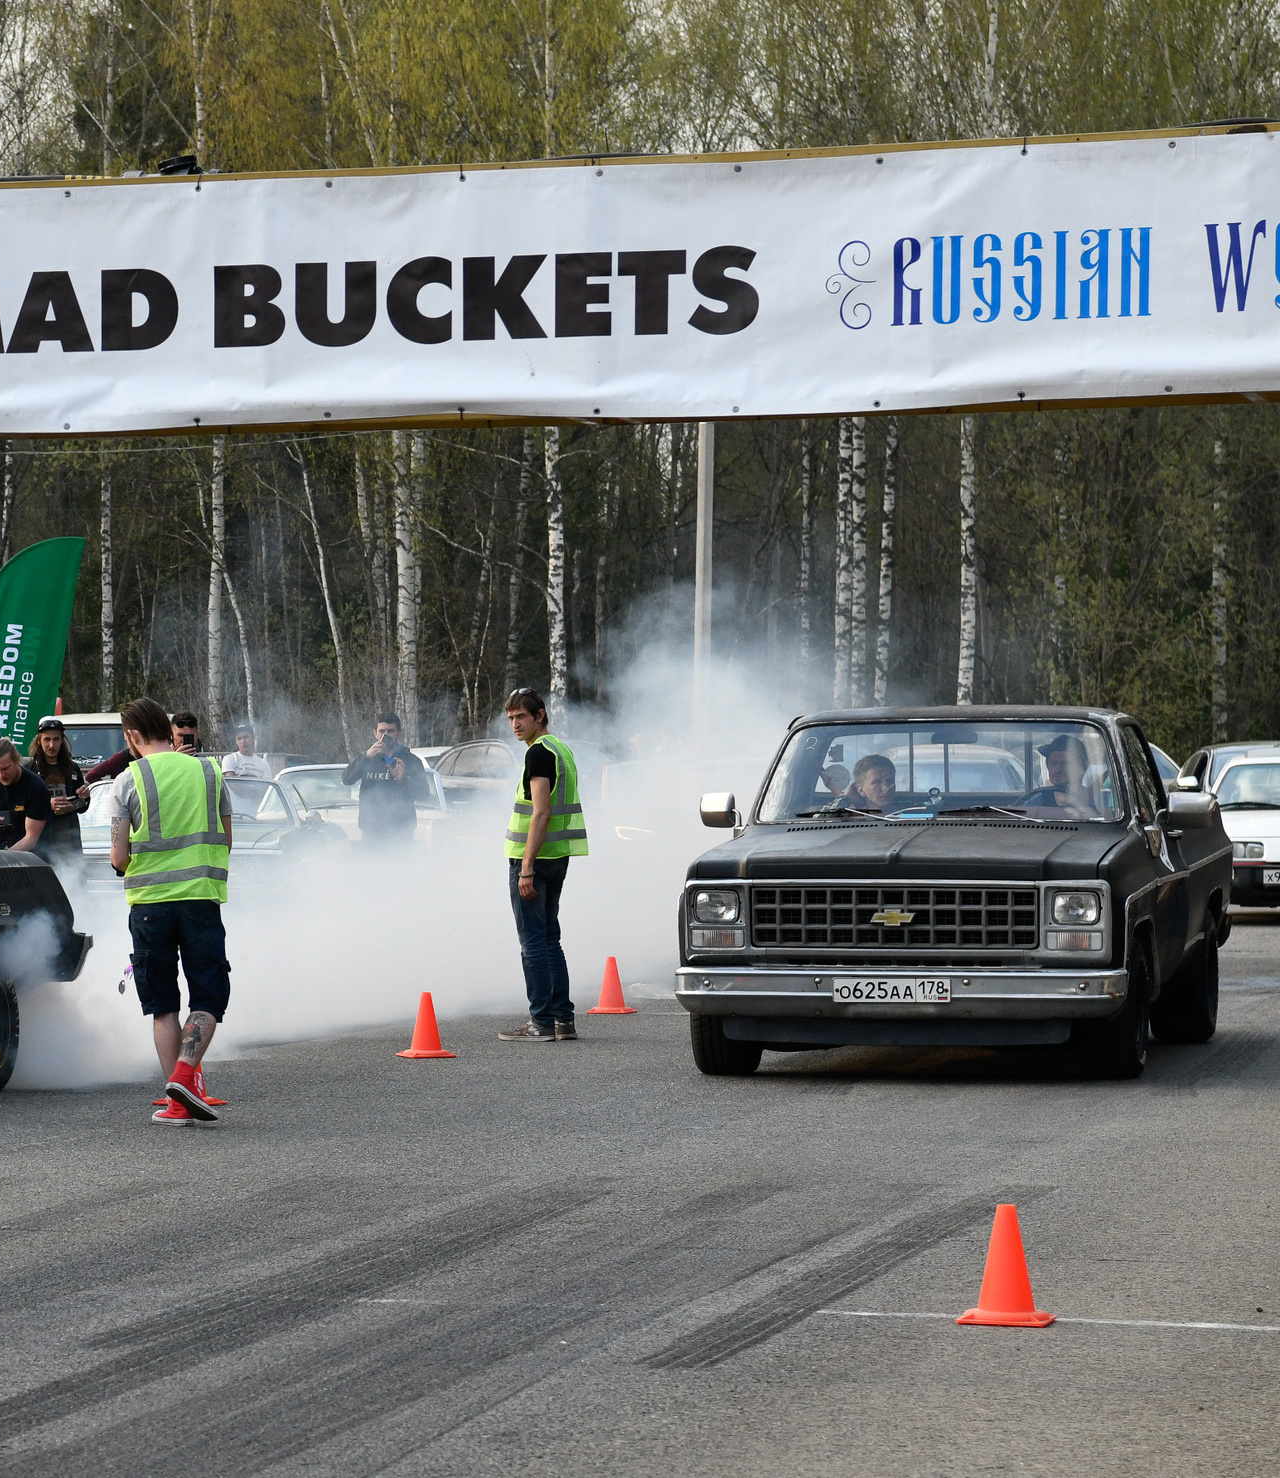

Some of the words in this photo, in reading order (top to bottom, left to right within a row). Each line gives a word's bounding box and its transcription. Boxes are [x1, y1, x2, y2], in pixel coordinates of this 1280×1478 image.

[214, 245, 760, 348] BUCKETS
[891, 227, 1153, 326] RUSSIAN
[1204, 219, 1280, 314] W
[9, 671, 34, 745] finance
[366, 771, 390, 780] NIKE
[918, 981, 945, 995] 178
